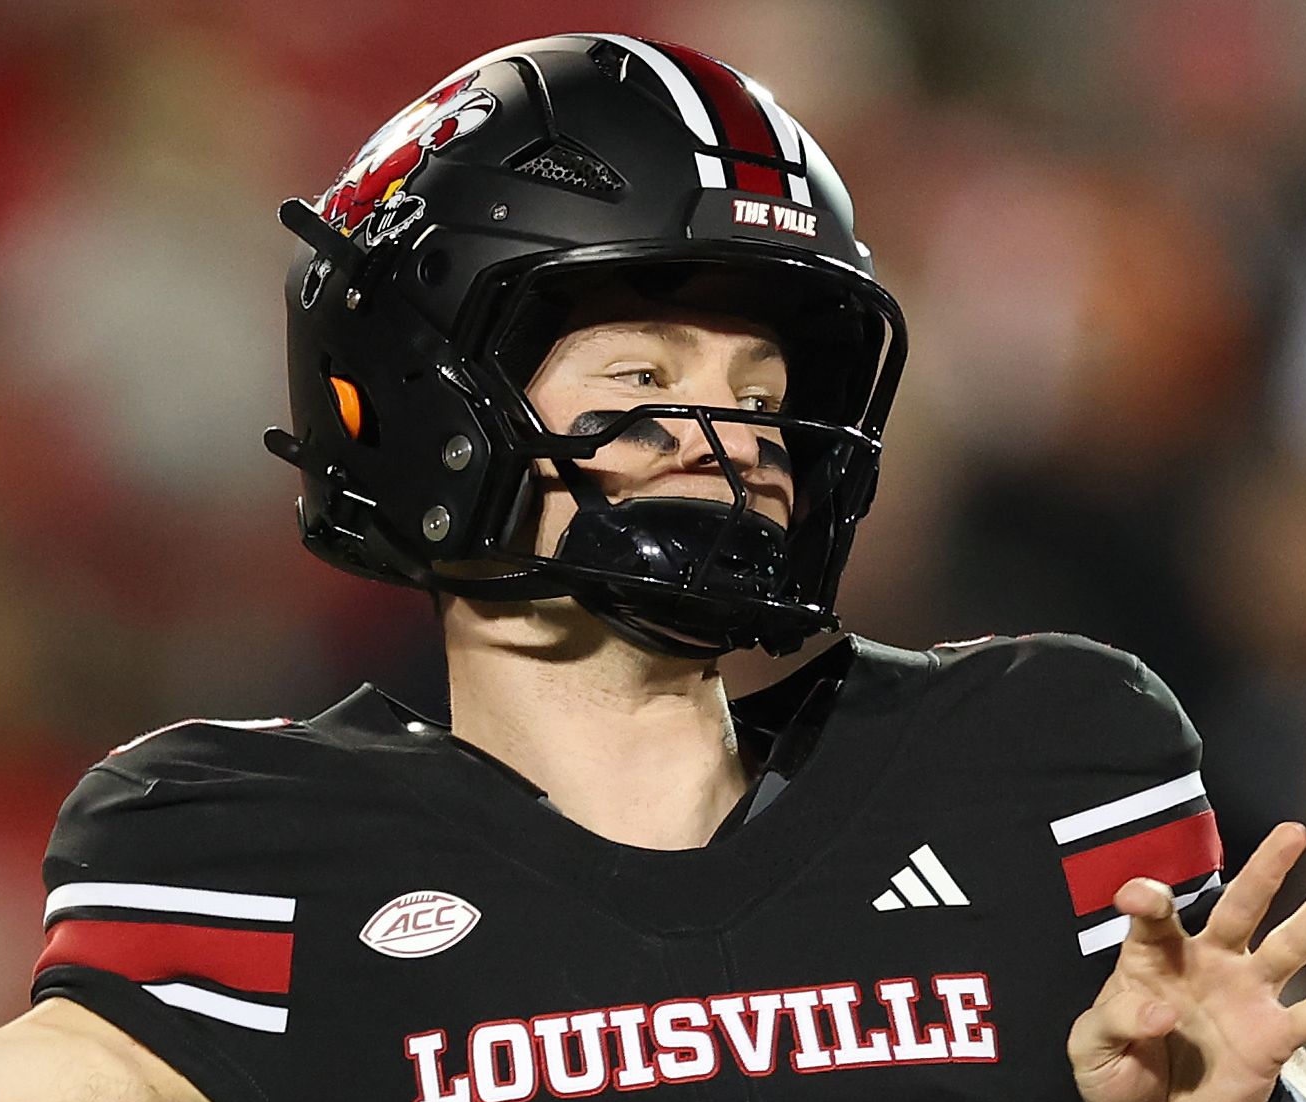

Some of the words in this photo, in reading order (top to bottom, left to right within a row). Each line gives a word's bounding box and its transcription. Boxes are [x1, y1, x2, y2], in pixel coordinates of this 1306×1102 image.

[733, 199, 770, 227] THE
[772, 205, 817, 237] VILLE
[381, 904, 458, 937] ACC
